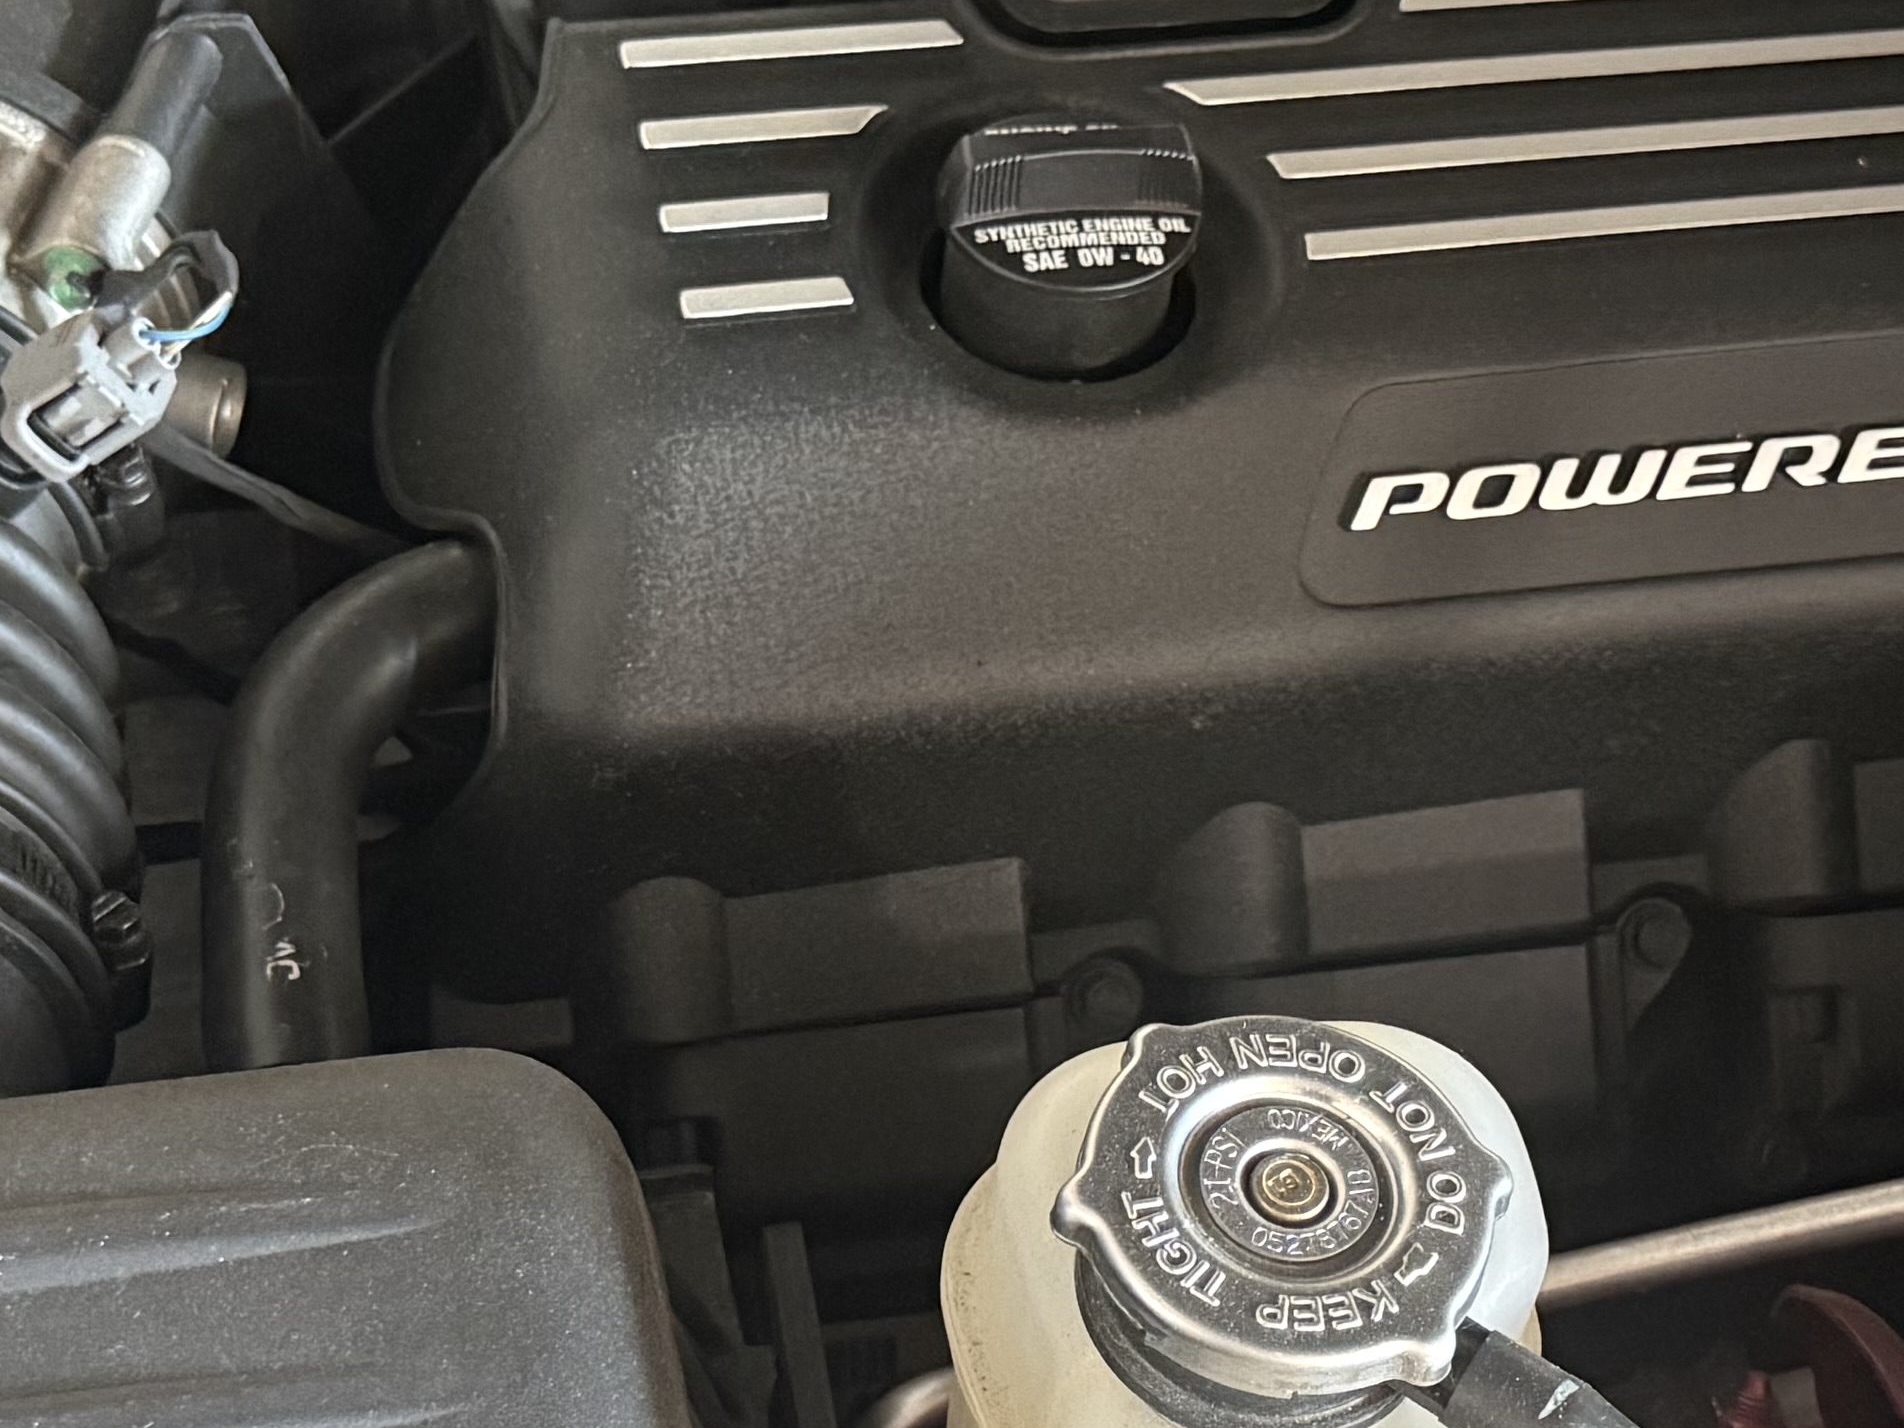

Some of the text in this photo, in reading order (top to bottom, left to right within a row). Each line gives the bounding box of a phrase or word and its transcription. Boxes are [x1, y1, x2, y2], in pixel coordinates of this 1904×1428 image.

[974, 216, 1192, 244] SYNTHETIC ENGINE OIL
[1005, 230, 1167, 254] RECOMMENDED
[1022, 249, 1070, 272] SAE
[1138, 1033, 1467, 1235] DO NOT OPEN HOT
[1267, 1108, 1349, 1151] MEXICO
[1120, 1190, 1400, 1332] KEEP TIGHT
